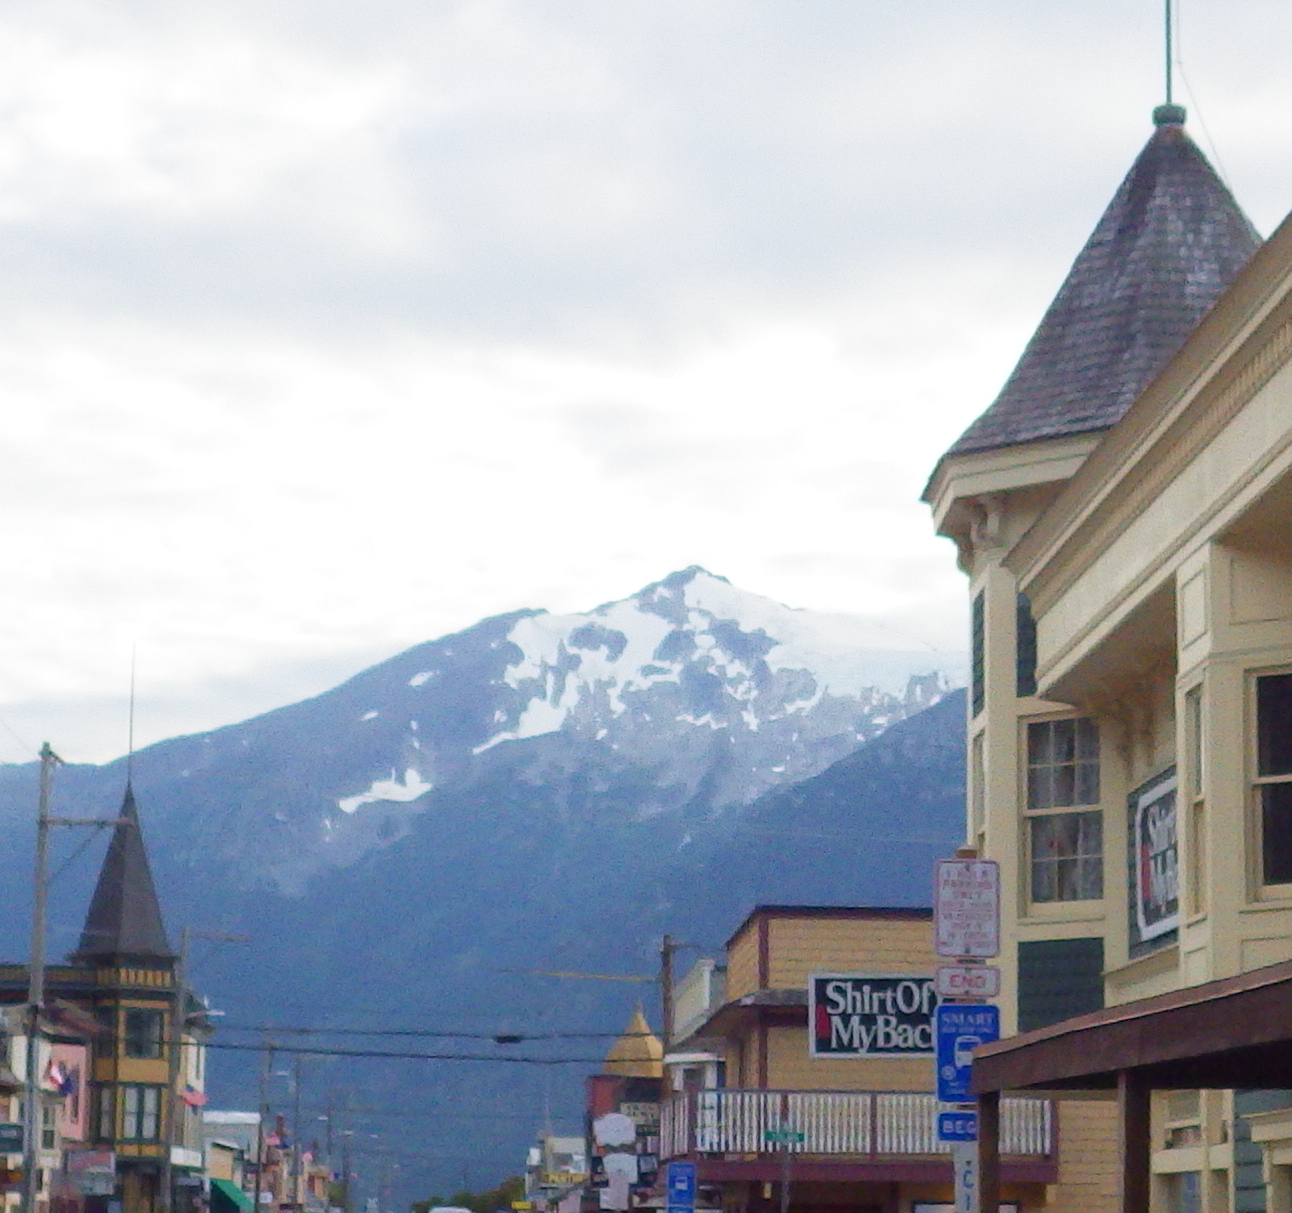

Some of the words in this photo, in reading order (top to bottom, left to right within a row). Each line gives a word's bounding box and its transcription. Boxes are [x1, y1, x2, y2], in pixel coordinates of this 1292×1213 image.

[949, 974, 986, 989] END
[941, 1012, 995, 1026] SMART
[942, 1119, 977, 1134] BEG
